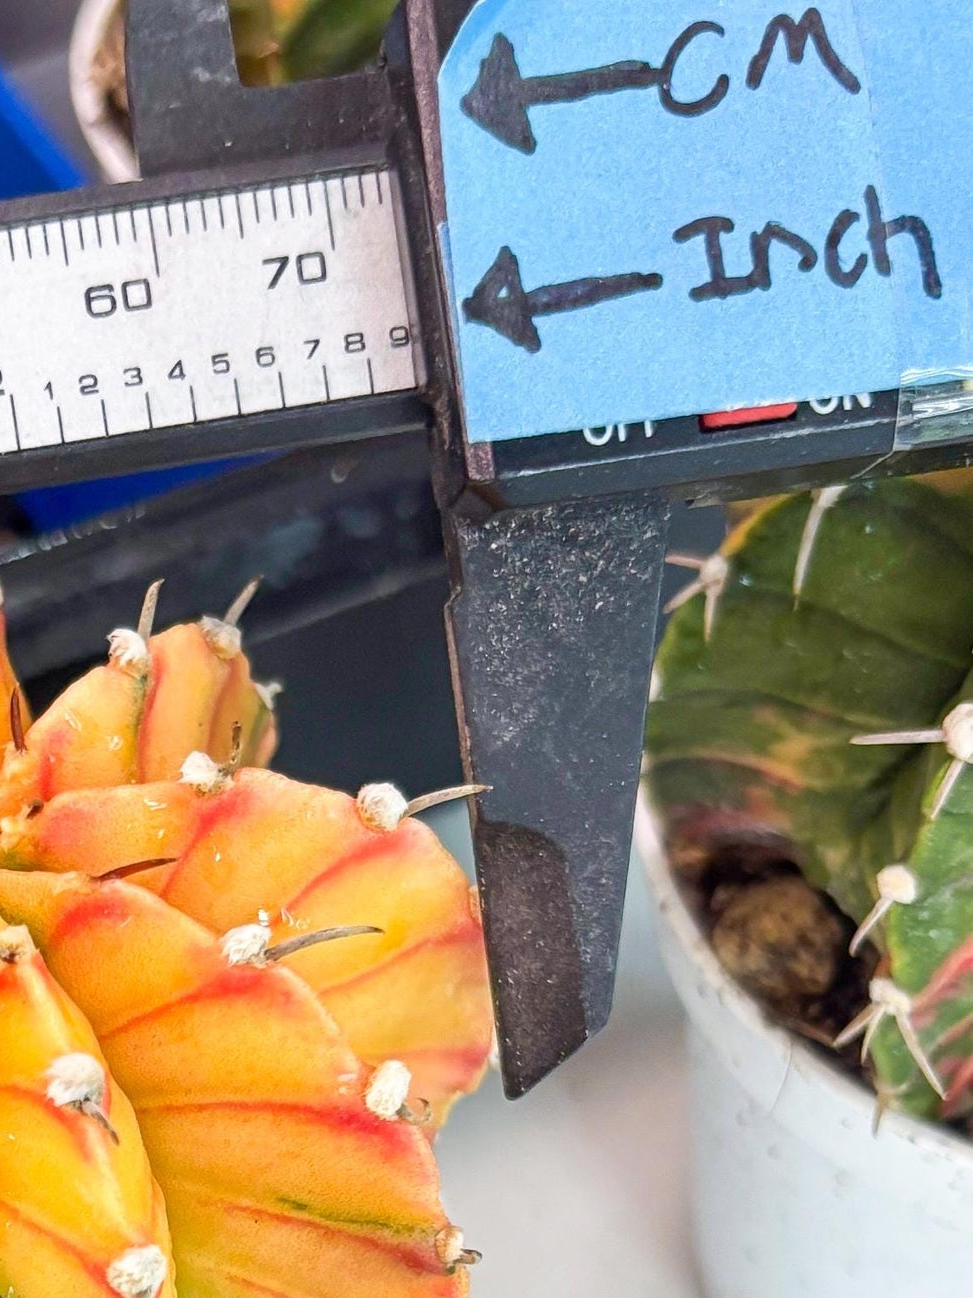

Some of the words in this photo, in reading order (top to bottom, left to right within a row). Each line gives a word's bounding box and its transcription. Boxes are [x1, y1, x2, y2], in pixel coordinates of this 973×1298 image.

[671, 184, 943, 300] Inch
[84, 278, 153, 318] 60
[262, 251, 327, 290] 70
[44, 381, 54, 400] 1
[78, 374, 99, 396] 2
[123, 366, 143, 387] 3
[167, 359, 186, 380] 4
[211, 352, 231, 374] 5
[255, 346, 276, 368] 6
[303, 338, 321, 360] 7
[343, 332, 367, 354] 8
[388, 325, 411, 347] 9
